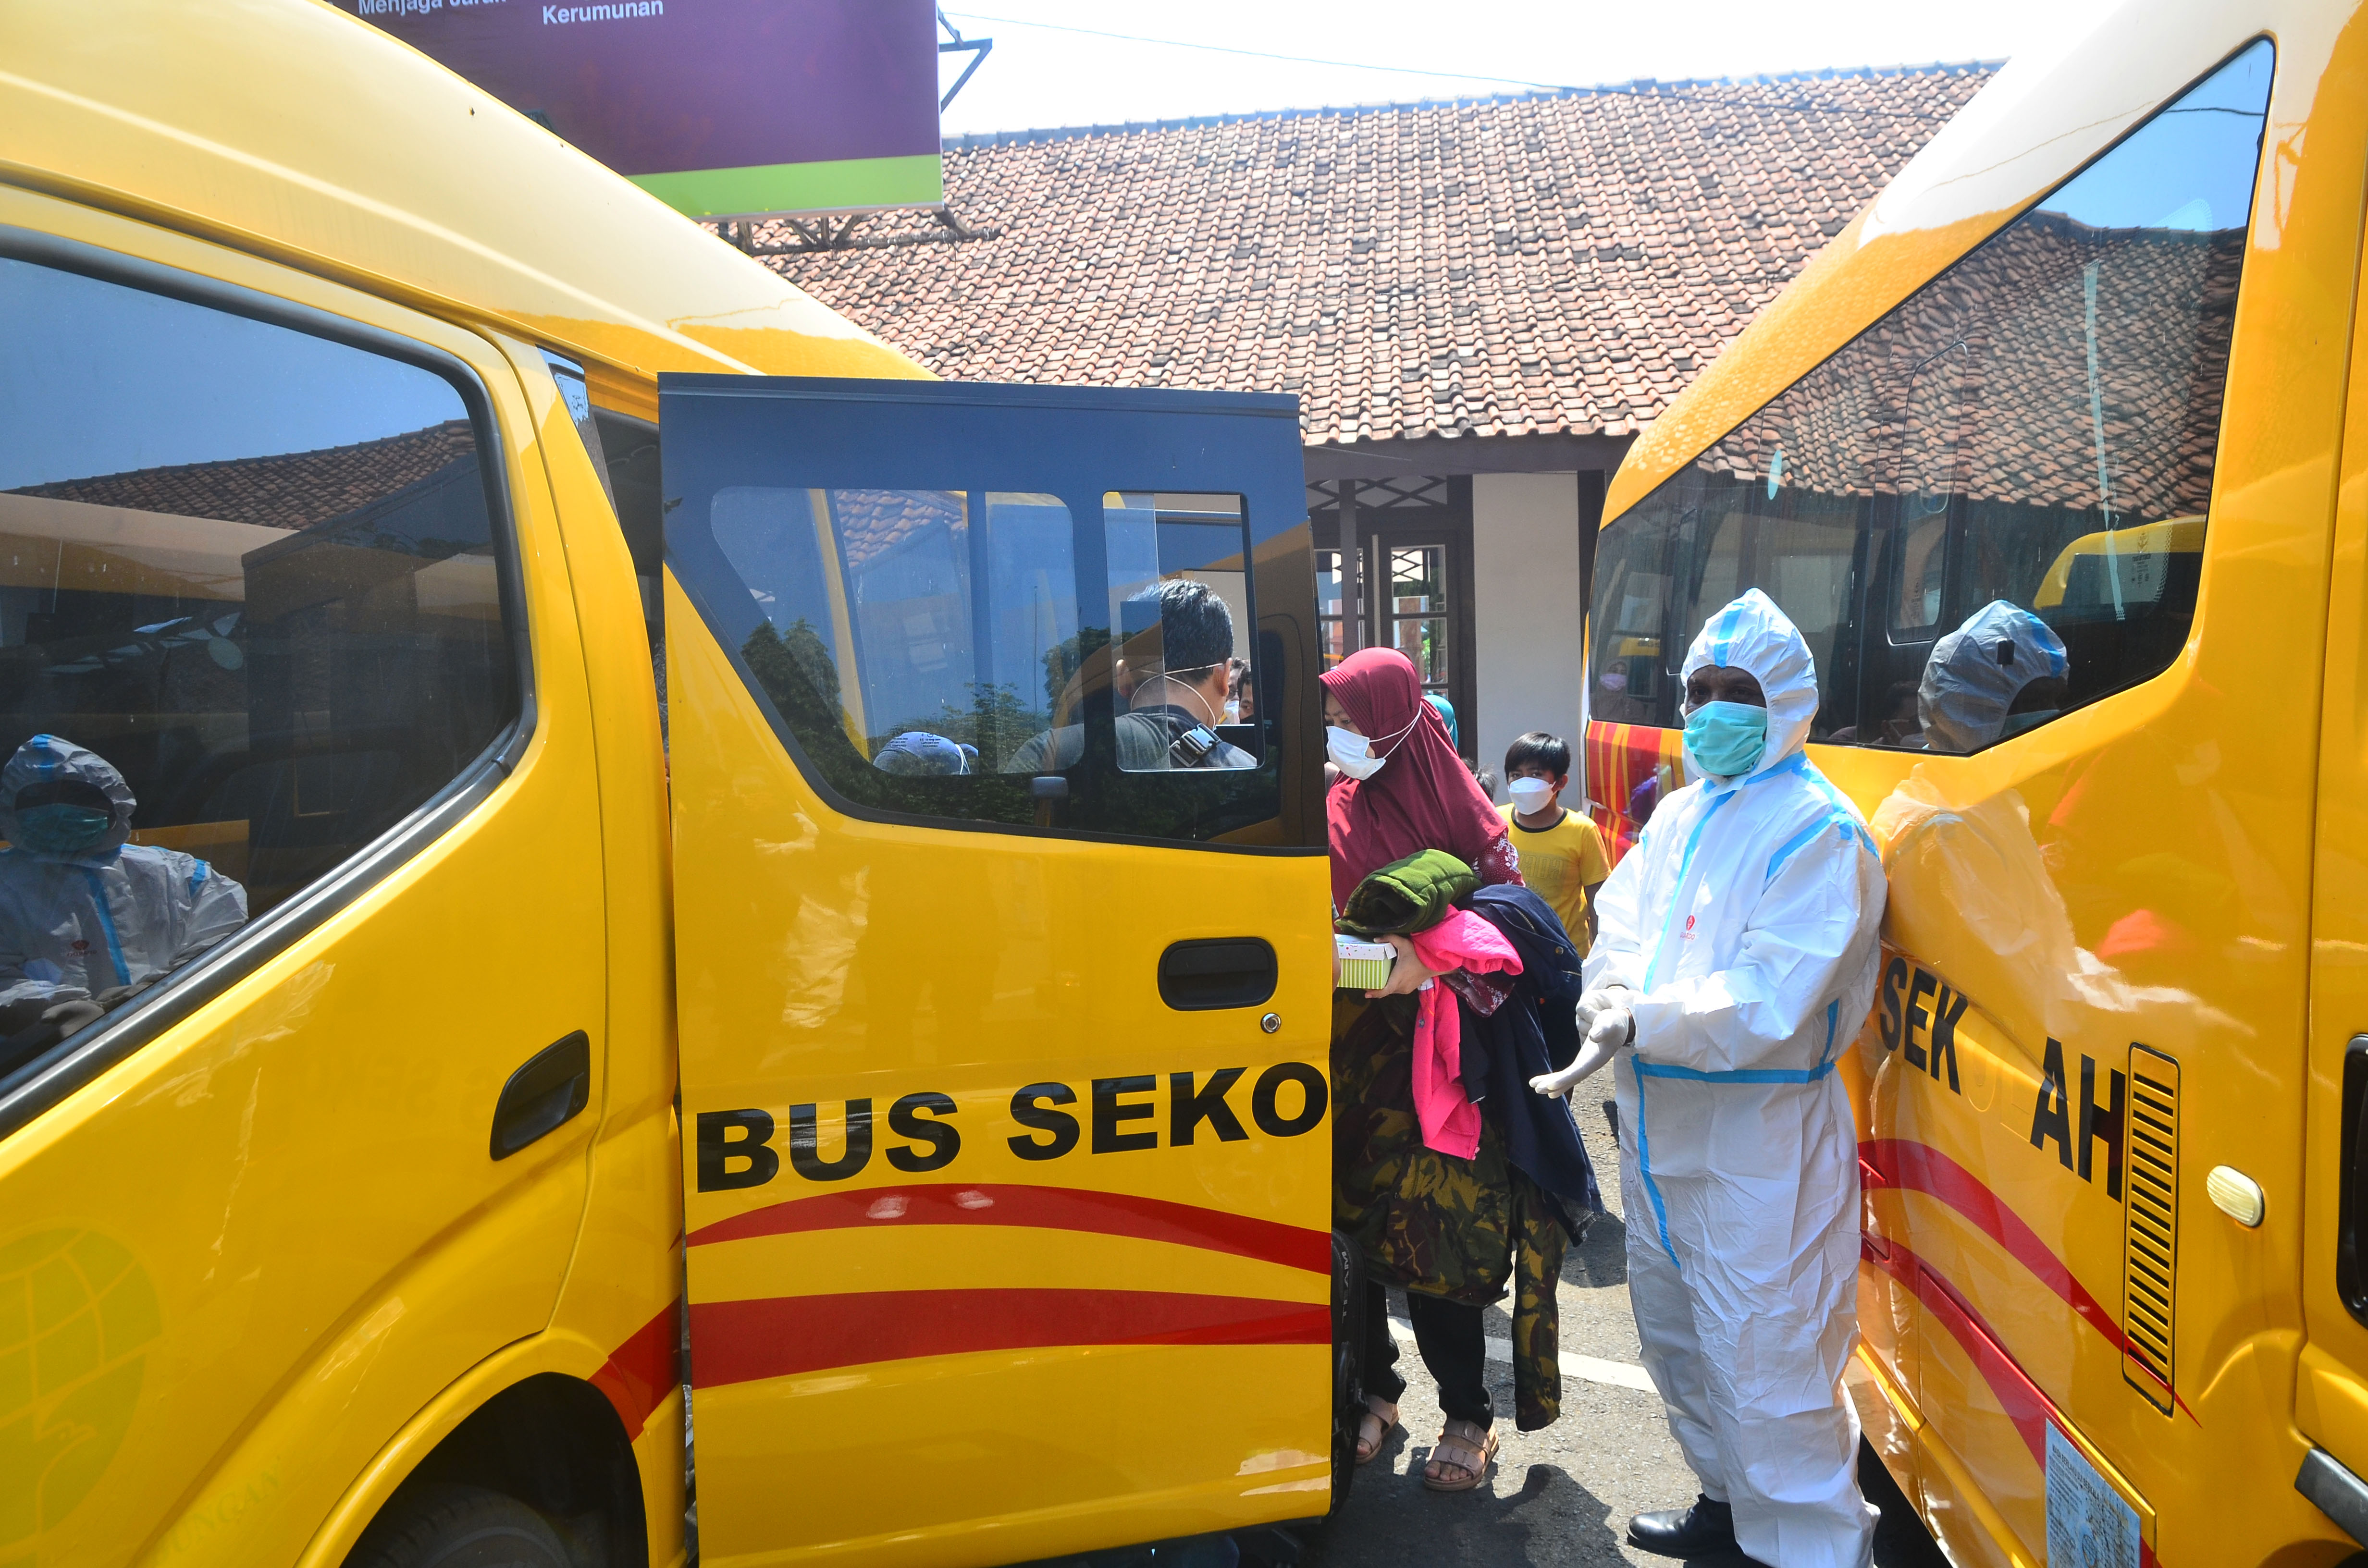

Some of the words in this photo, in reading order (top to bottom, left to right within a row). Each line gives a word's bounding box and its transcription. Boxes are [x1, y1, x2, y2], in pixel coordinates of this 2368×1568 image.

[358, 0, 443, 16] Menjaga
[543, 0, 664, 24] Kerumunan
[697, 1092, 961, 1193] BUS
[1007, 1062, 1329, 1161] SEKO
